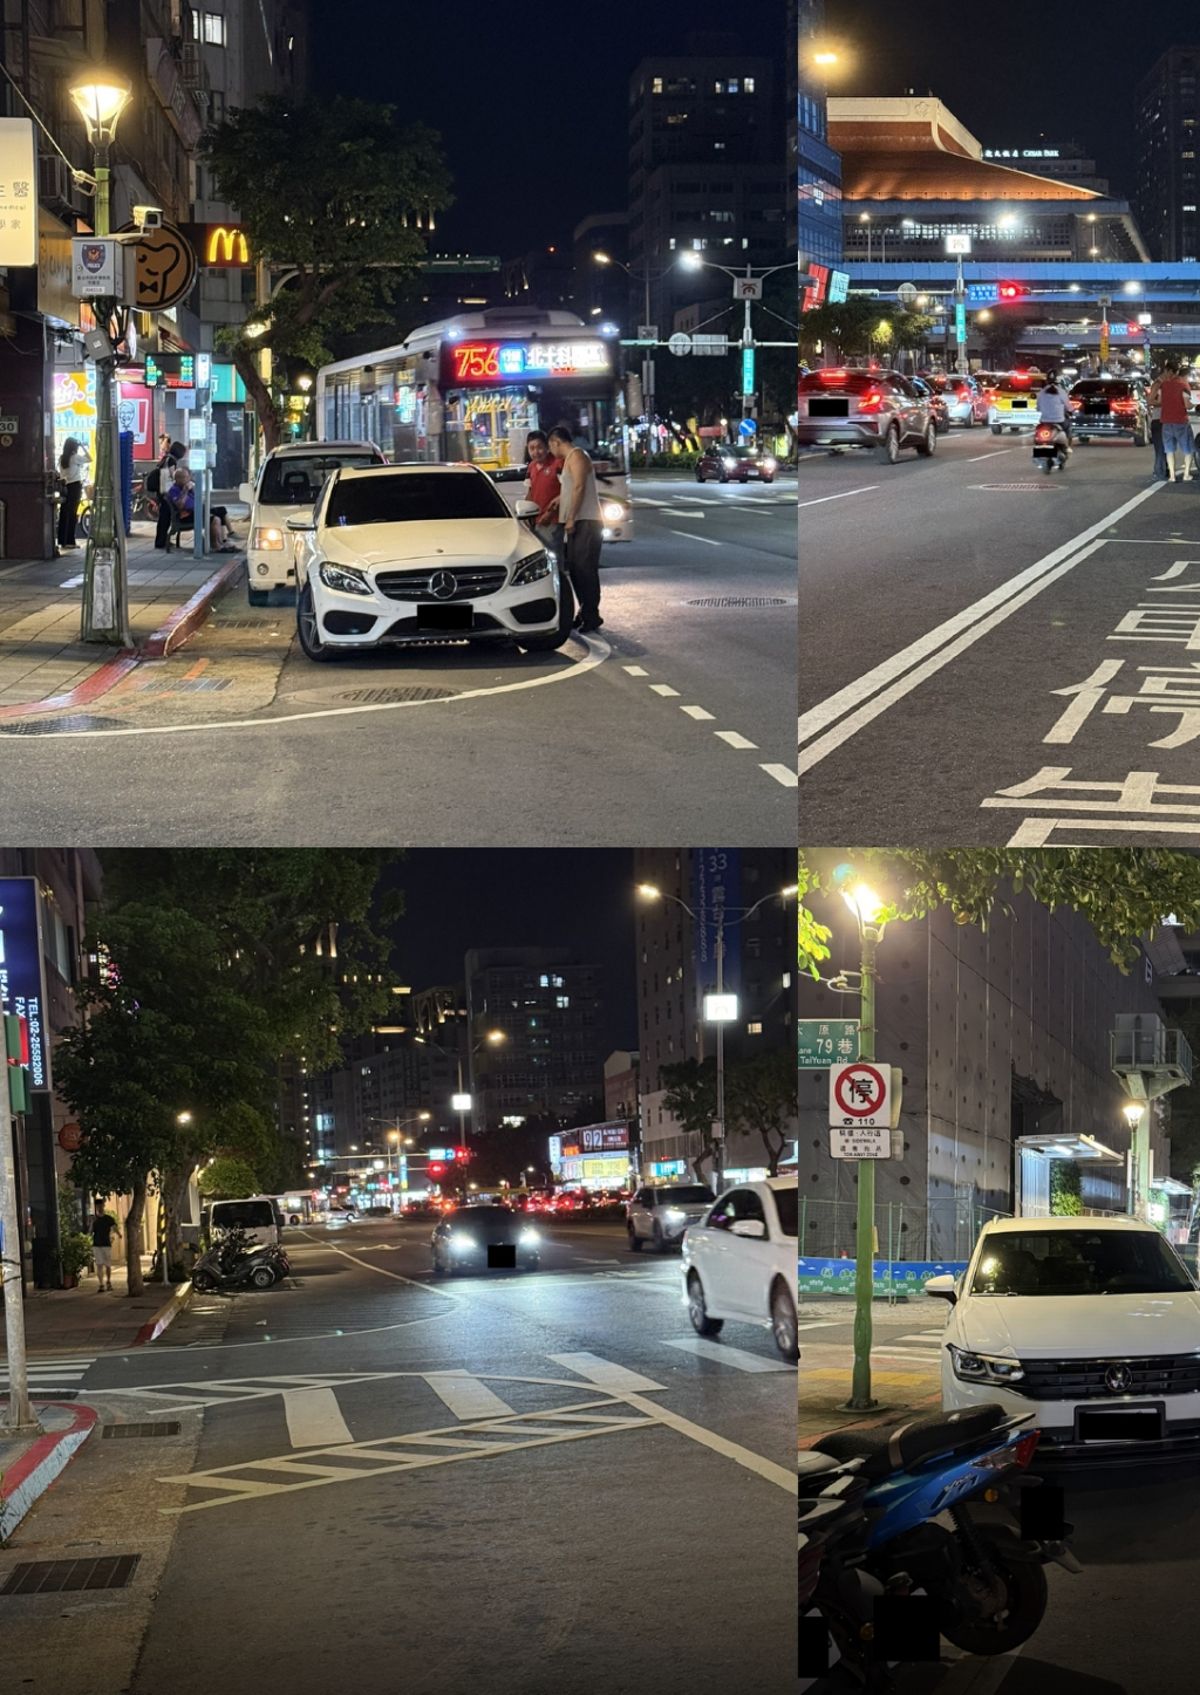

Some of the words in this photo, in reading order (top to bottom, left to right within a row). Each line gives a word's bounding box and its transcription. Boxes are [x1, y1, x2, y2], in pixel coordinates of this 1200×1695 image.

[454, 347, 499, 377] 756
[798, 1047, 812, 1055] ane
[849, 1078, 873, 1104] 停
[858, 1118, 875, 1126] 110
